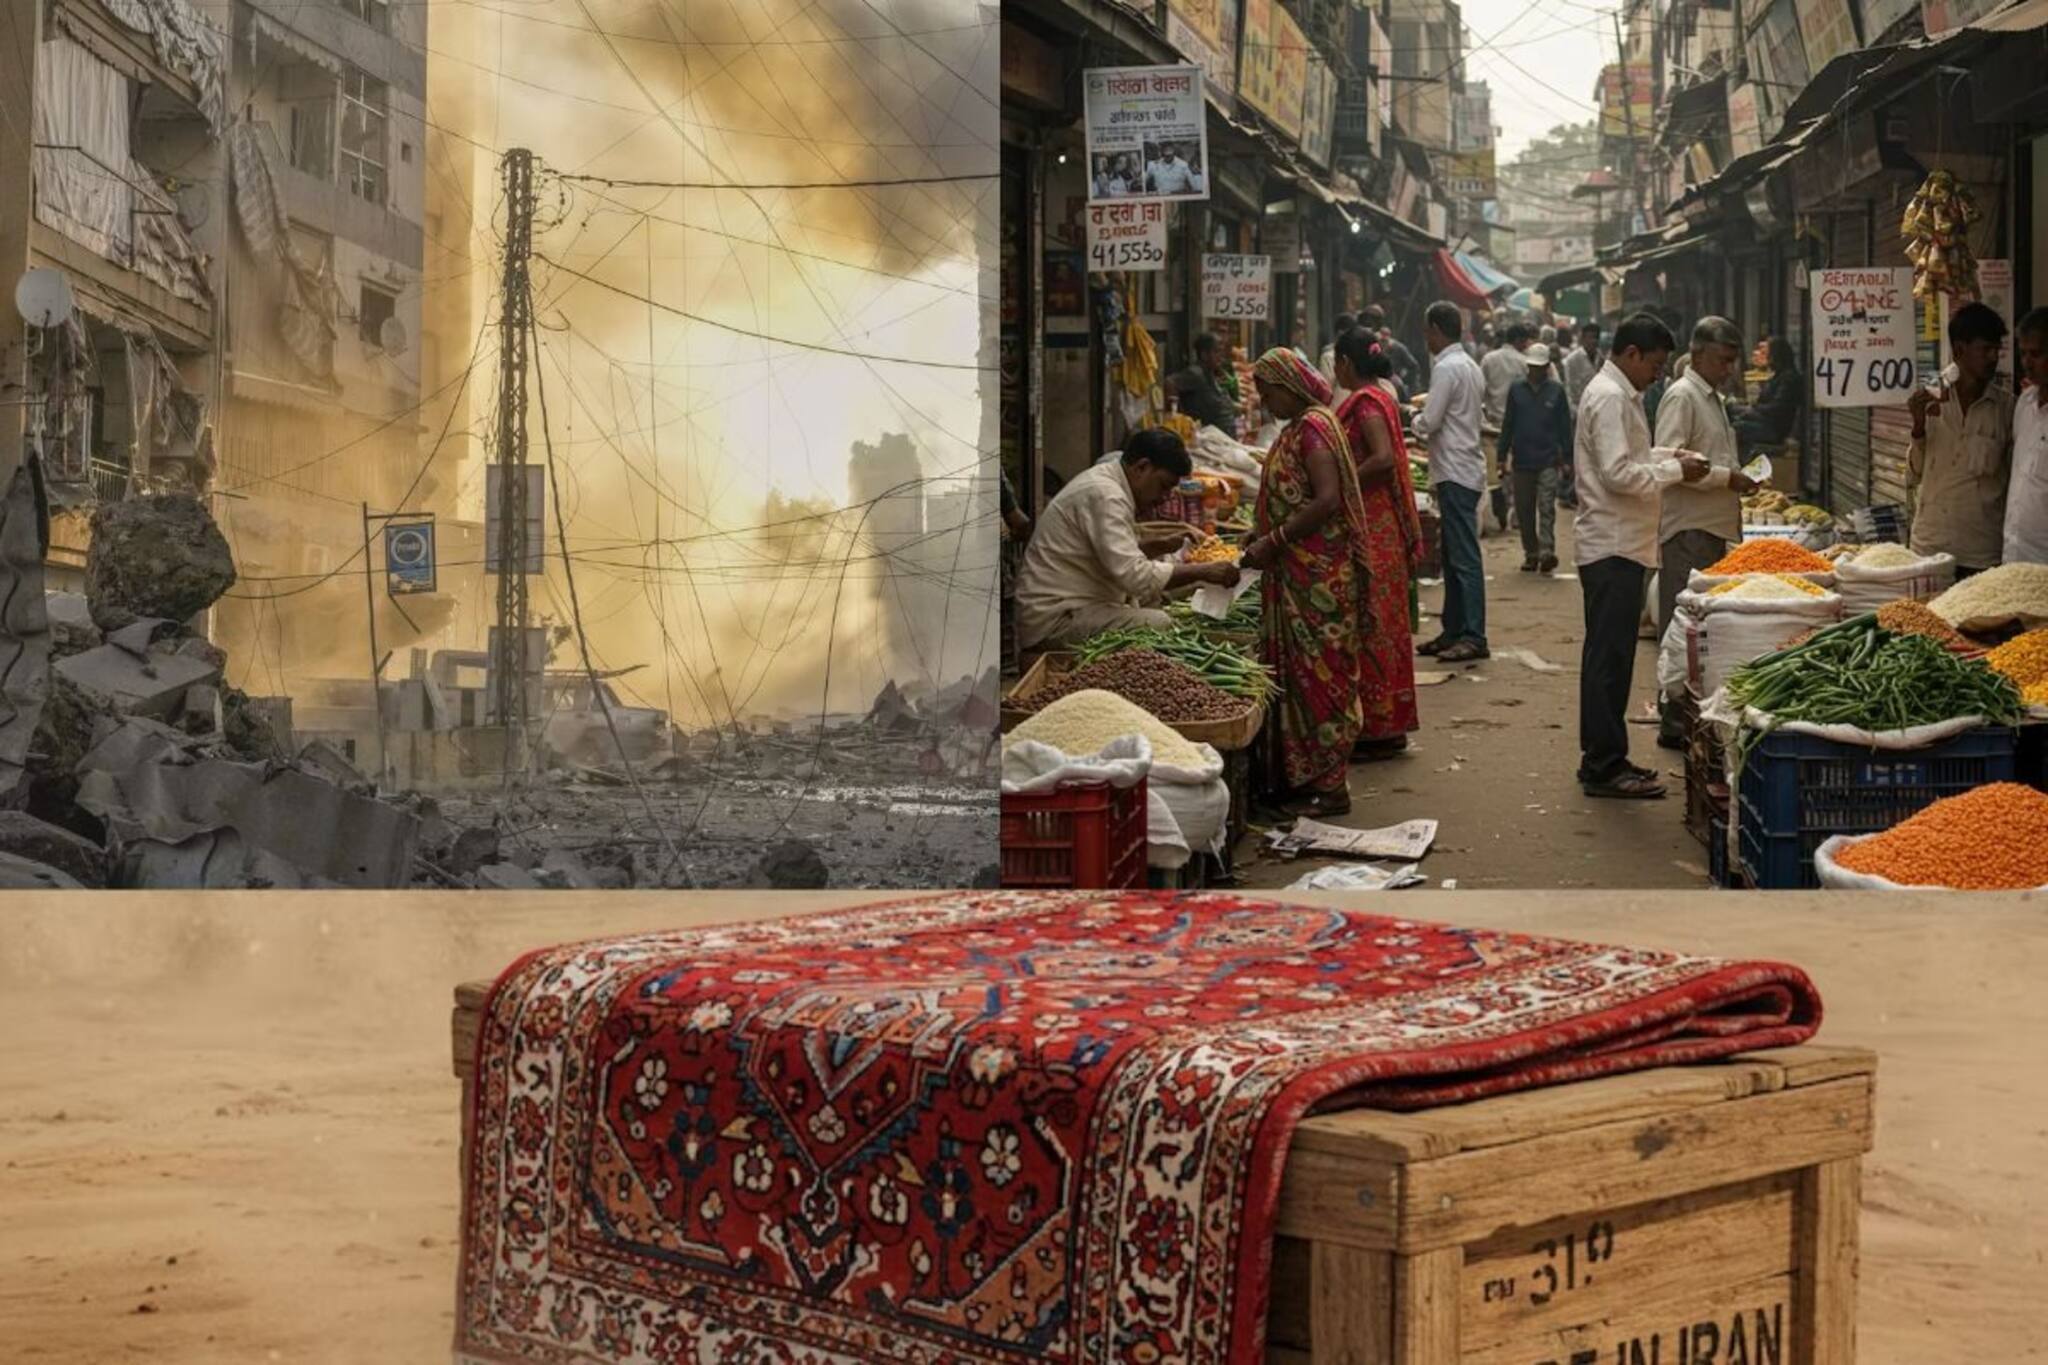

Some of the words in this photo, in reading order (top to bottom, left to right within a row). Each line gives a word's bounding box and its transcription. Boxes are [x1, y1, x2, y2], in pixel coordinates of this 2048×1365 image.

[1816, 356, 1854, 397] 47
[1867, 357, 1913, 392] 600
[1678, 1303, 1783, 1365] IRAN
